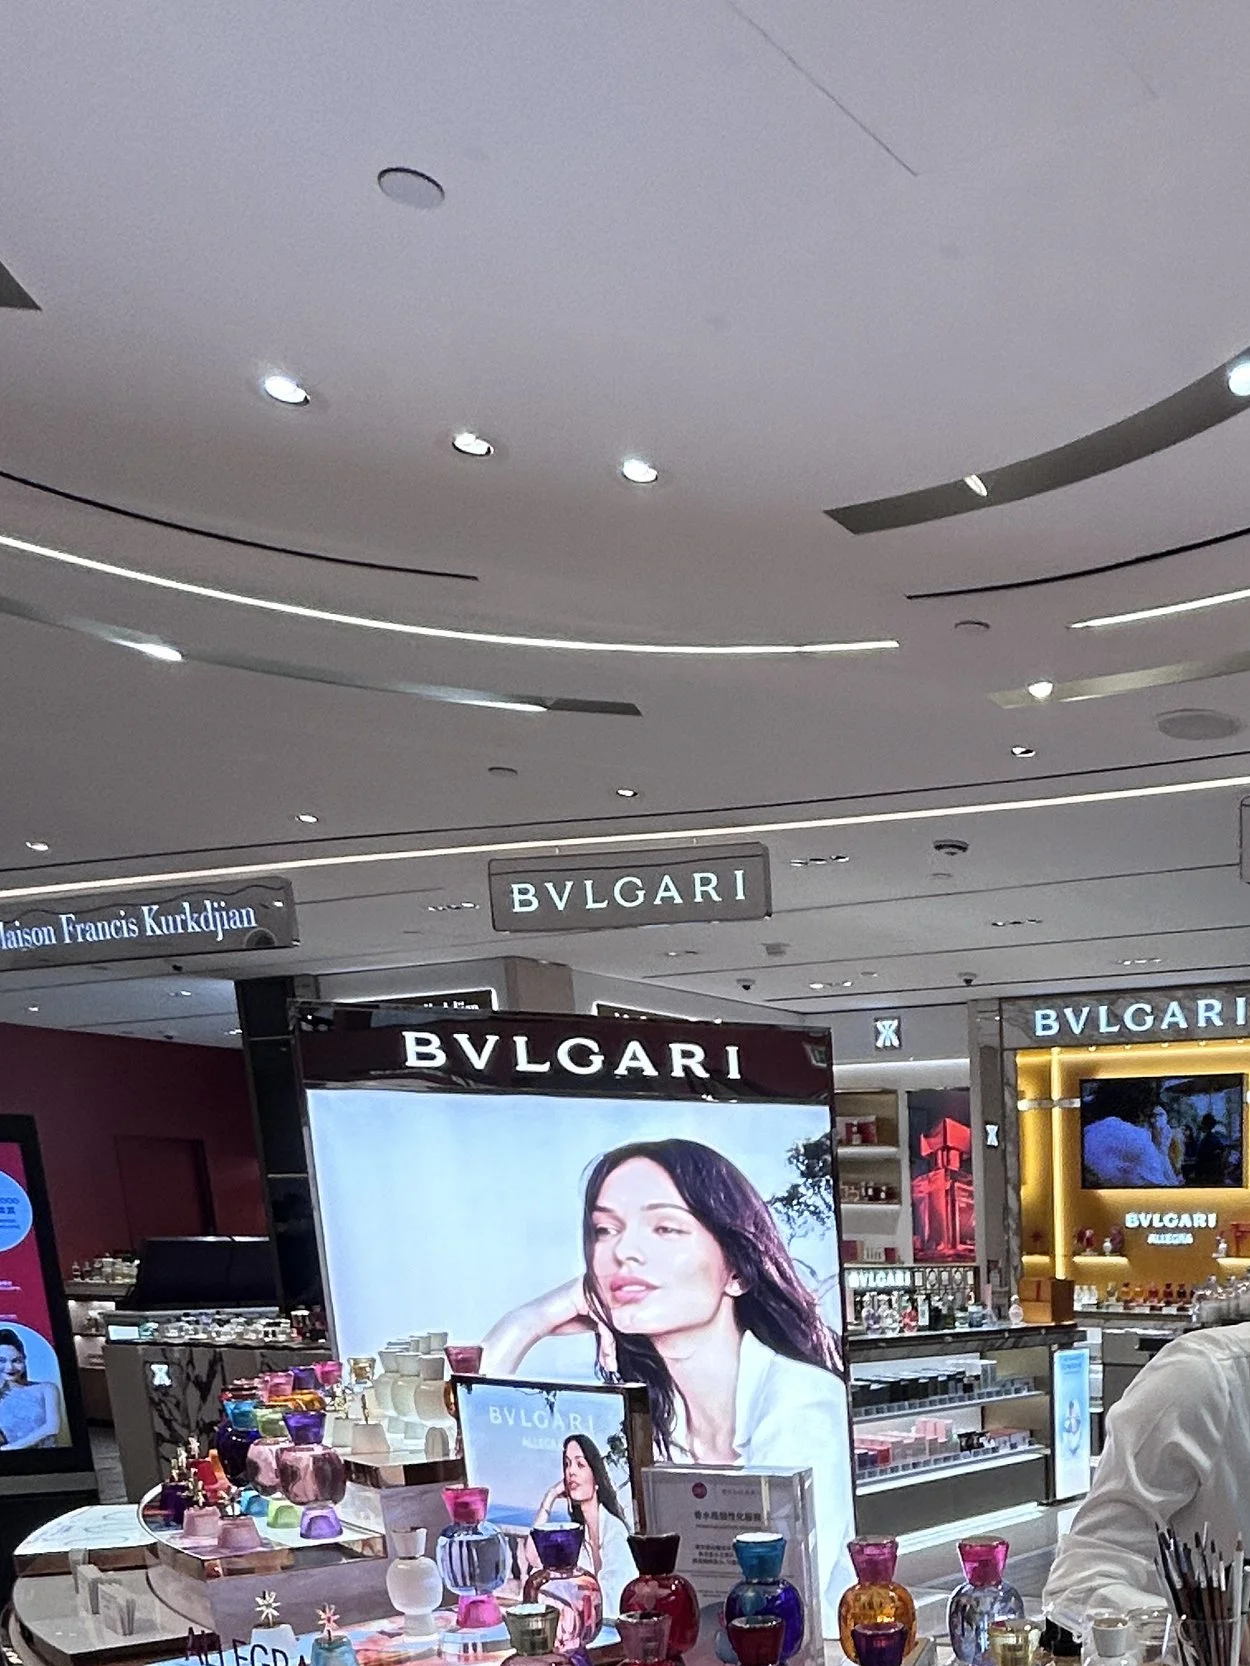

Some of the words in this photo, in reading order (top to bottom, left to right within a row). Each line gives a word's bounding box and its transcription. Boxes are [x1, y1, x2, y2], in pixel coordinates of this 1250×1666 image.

[511, 870, 745, 912] BVLGARI
[59, 911, 138, 944] Francis
[140, 899, 257, 942] Kurkdjian
[1035, 997, 1247, 1036] BVLGARI
[402, 1031, 741, 1079] BVLGARI
[1125, 1212, 1217, 1228] BVLGARI
[489, 1406, 595, 1435] BVLGARI
